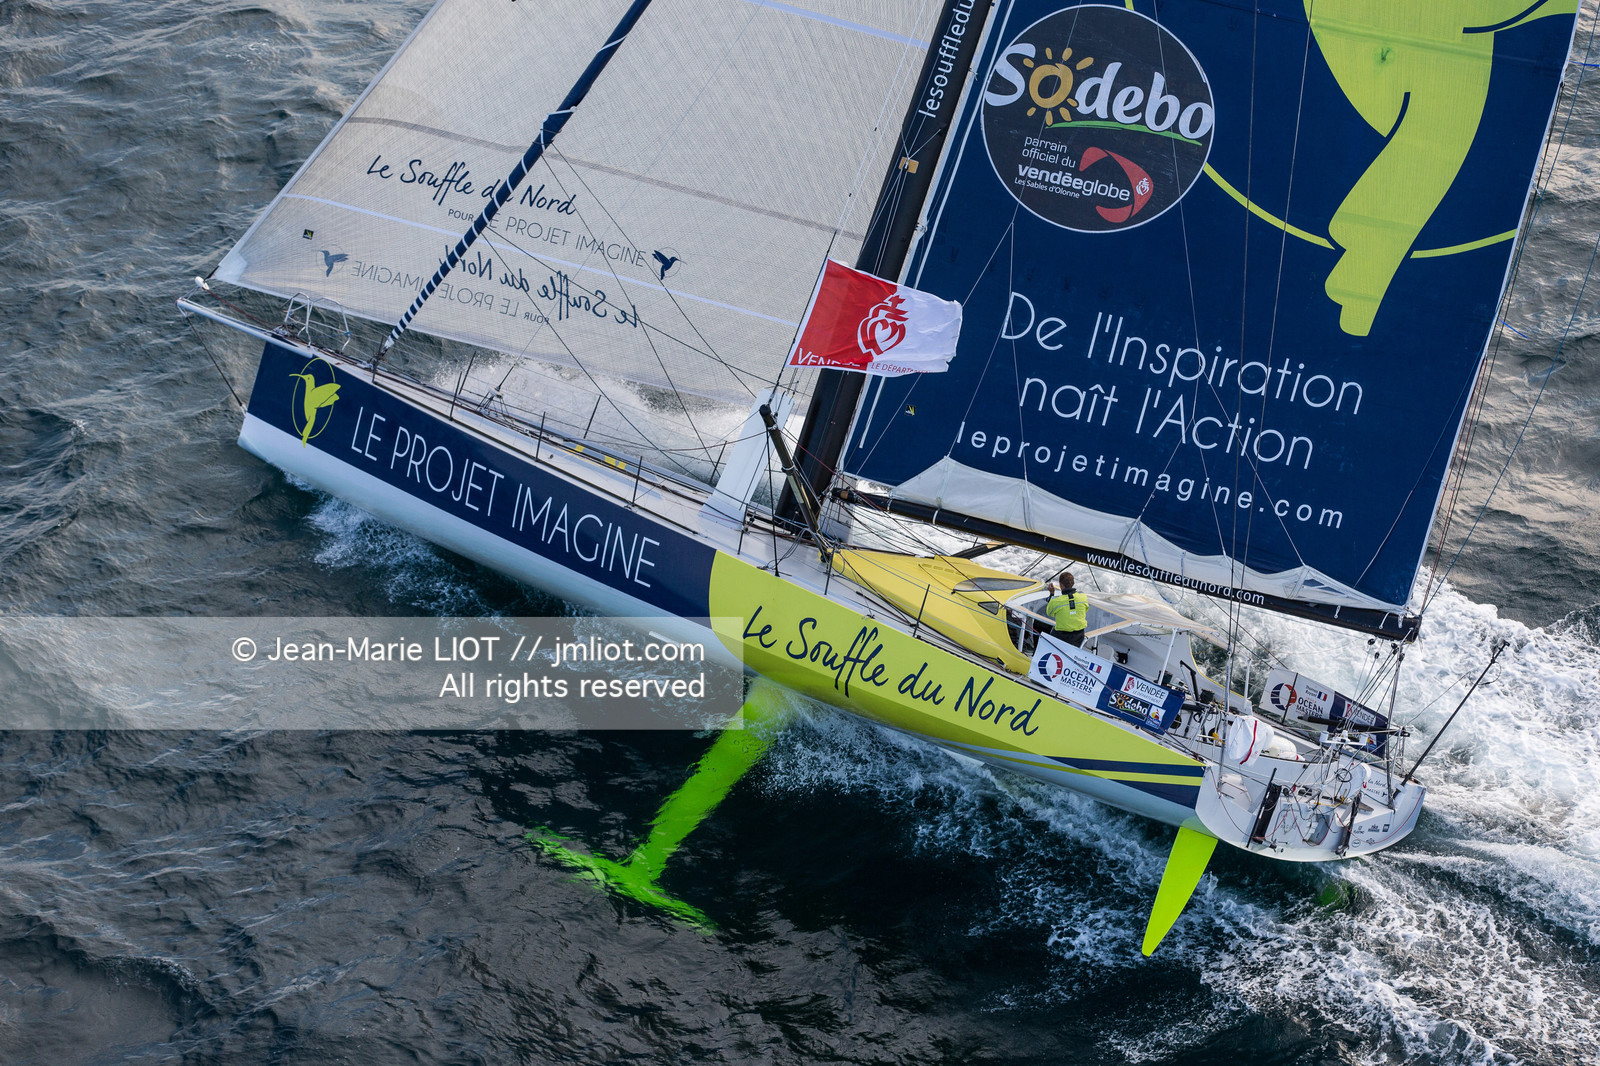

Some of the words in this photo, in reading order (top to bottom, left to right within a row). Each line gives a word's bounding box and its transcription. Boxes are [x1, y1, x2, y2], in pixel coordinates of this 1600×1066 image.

[984, 43, 1214, 139] Sodebo
[1022, 148, 1059, 164] officiel
[1061, 156, 1076, 168] du
[1024, 136, 1067, 153] parrain
[367, 155, 393, 179] Le
[400, 159, 474, 206] Souffle
[481, 179, 514, 203] d
[520, 184, 577, 215] Nord
[1014, 177, 1027, 186] Les
[1026, 180, 1048, 192] Sables
[1048, 185, 1080, 199] d'Olonne
[448, 209, 475, 222] POUR
[506, 216, 571, 246] PROJET
[576, 234, 647, 267] IMAGINE
[871, 361, 880, 370] LE
[1001, 291, 1067, 350] De
[1087, 311, 1364, 415] l'Inspiration
[1019, 377, 1118, 426] naît
[1135, 387, 1314, 470] l'Action
[351, 406, 386, 461] LE
[390, 426, 504, 517] PROJET
[511, 482, 660, 588] IMAGINE
[956, 421, 1344, 528] leprojetimagine.com
[1086, 553, 1265, 605] www.lesouffledunord.com
[742, 606, 777, 649] Le
[786, 617, 889, 698] Souffle
[898, 662, 945, 706] du
[954, 676, 1042, 736] Nord
[1060, 675, 1093, 694] MASTERS
[1063, 667, 1097, 687] OCEAN
[1136, 680, 1166, 699] VENDÉE
[1297, 697, 1324, 714] OCEAN
